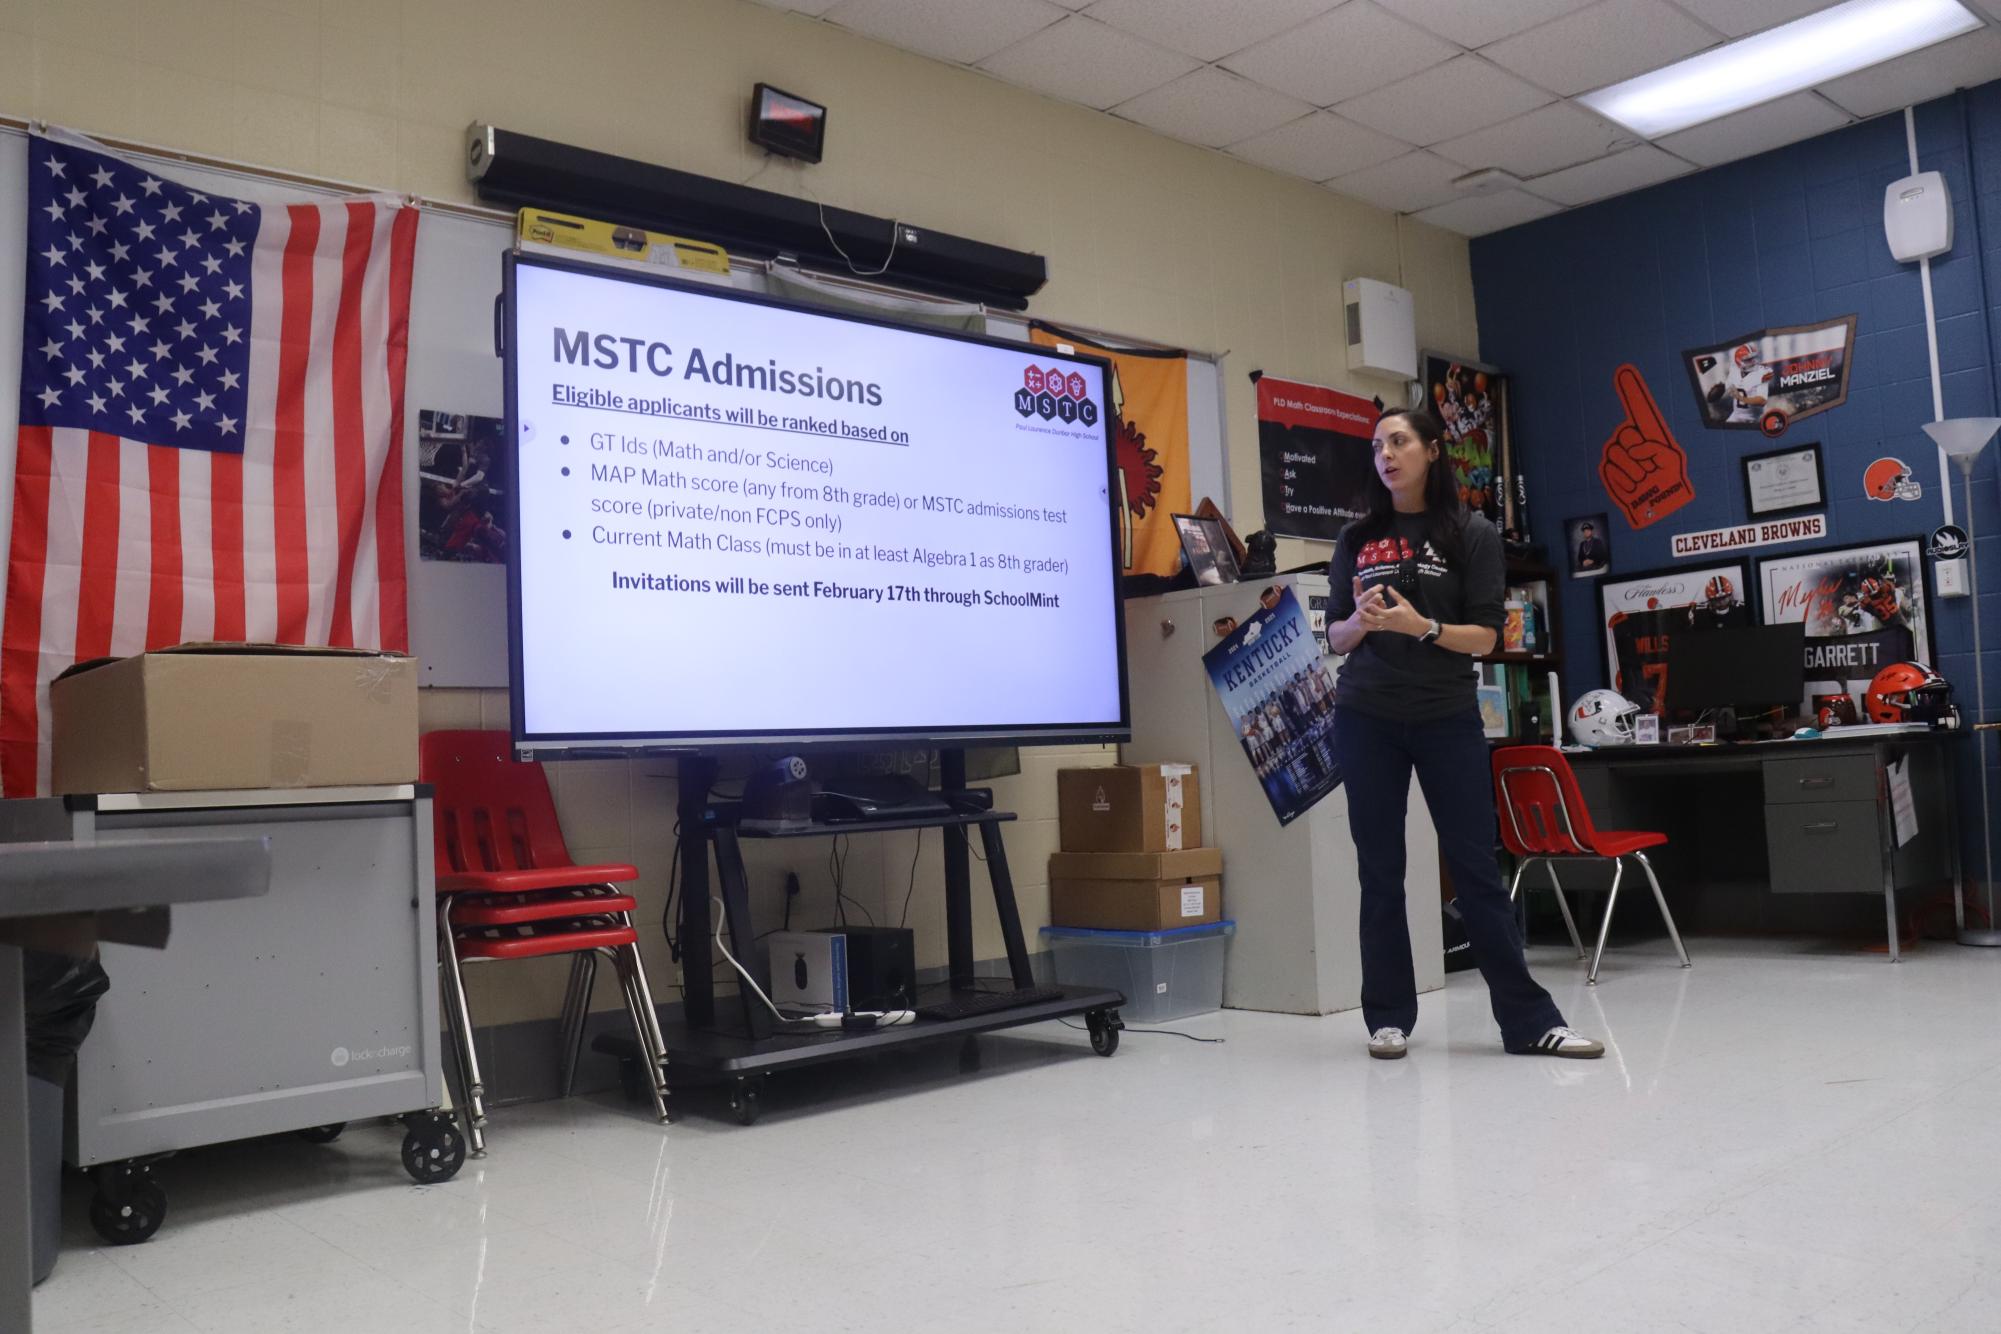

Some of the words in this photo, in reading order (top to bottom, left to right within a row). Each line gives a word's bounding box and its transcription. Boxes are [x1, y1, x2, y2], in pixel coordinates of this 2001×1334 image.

[554, 327, 673, 377] MSTC
[684, 348, 883, 406] Admissions
[1780, 368, 1836, 388] MANZIEL
[552, 384, 624, 407] Eligible
[628, 396, 721, 422] applicants
[725, 407, 754, 425] will
[758, 409, 778, 427] be
[782, 416, 838, 435] ranked
[841, 420, 887, 441] based
[890, 431, 909, 444] on
[1018, 394, 1093, 420] MSTC
[1274, 397, 1286, 407] PLD
[1287, 400, 1304, 410] Math
[590, 432, 616, 451] GT
[621, 435, 648, 455] Ids
[653, 439, 703, 461] (Math
[707, 447, 762, 468] and/or
[766, 451, 834, 476] Science)
[1284, 452, 1316, 464] Motivated
[1284, 468, 1296, 479] Ask
[1285, 485, 1294, 496] Try
[591, 463, 636, 484] MAP
[642, 468, 687, 489] Math
[691, 477, 739, 494] score
[743, 478, 776, 500] (any
[781, 481, 819, 501] from
[823, 485, 849, 502] 8th
[853, 491, 900, 510] grade)
[903, 496, 918, 509] or
[922, 495, 964, 514] MSTC
[967, 501, 1040, 521] admissions
[1043, 506, 1067, 523] test
[1286, 503, 1302, 514] Have
[1309, 505, 1331, 516] Positive
[591, 498, 643, 515] score
[648, 499, 751, 523] (private/non
[756, 507, 801, 527] FCPS
[805, 513, 842, 533] only)
[592, 525, 662, 548] Current
[667, 530, 712, 551] Math
[716, 533, 762, 554] Class
[766, 537, 812, 558] (must
[815, 541, 834, 558] be
[838, 543, 851, 559] in
[855, 545, 870, 560] at
[874, 545, 908, 562] least
[912, 548, 967, 568] Algebra
[970, 551, 976, 567] 1
[979, 555, 995, 568] as
[998, 553, 1020, 570] 8th
[1023, 558, 1068, 575] grader)
[1676, 528, 1756, 553] CLEVELAND
[1761, 519, 1821, 541] BROWNS
[612, 571, 711, 592] Invitations
[715, 577, 744, 594] will
[748, 577, 769, 595] be
[773, 580, 809, 597] sent
[813, 581, 884, 603] February
[887, 585, 921, 602] 17th
[923, 587, 981, 607] through
[984, 590, 1060, 608] SchoolMint
[1222, 617, 1301, 691] KENTUCKY
[1635, 635, 1670, 655] WILLS
[1804, 643, 1880, 668] GARRETT
[1249, 652, 1291, 688] BASKETBALL
